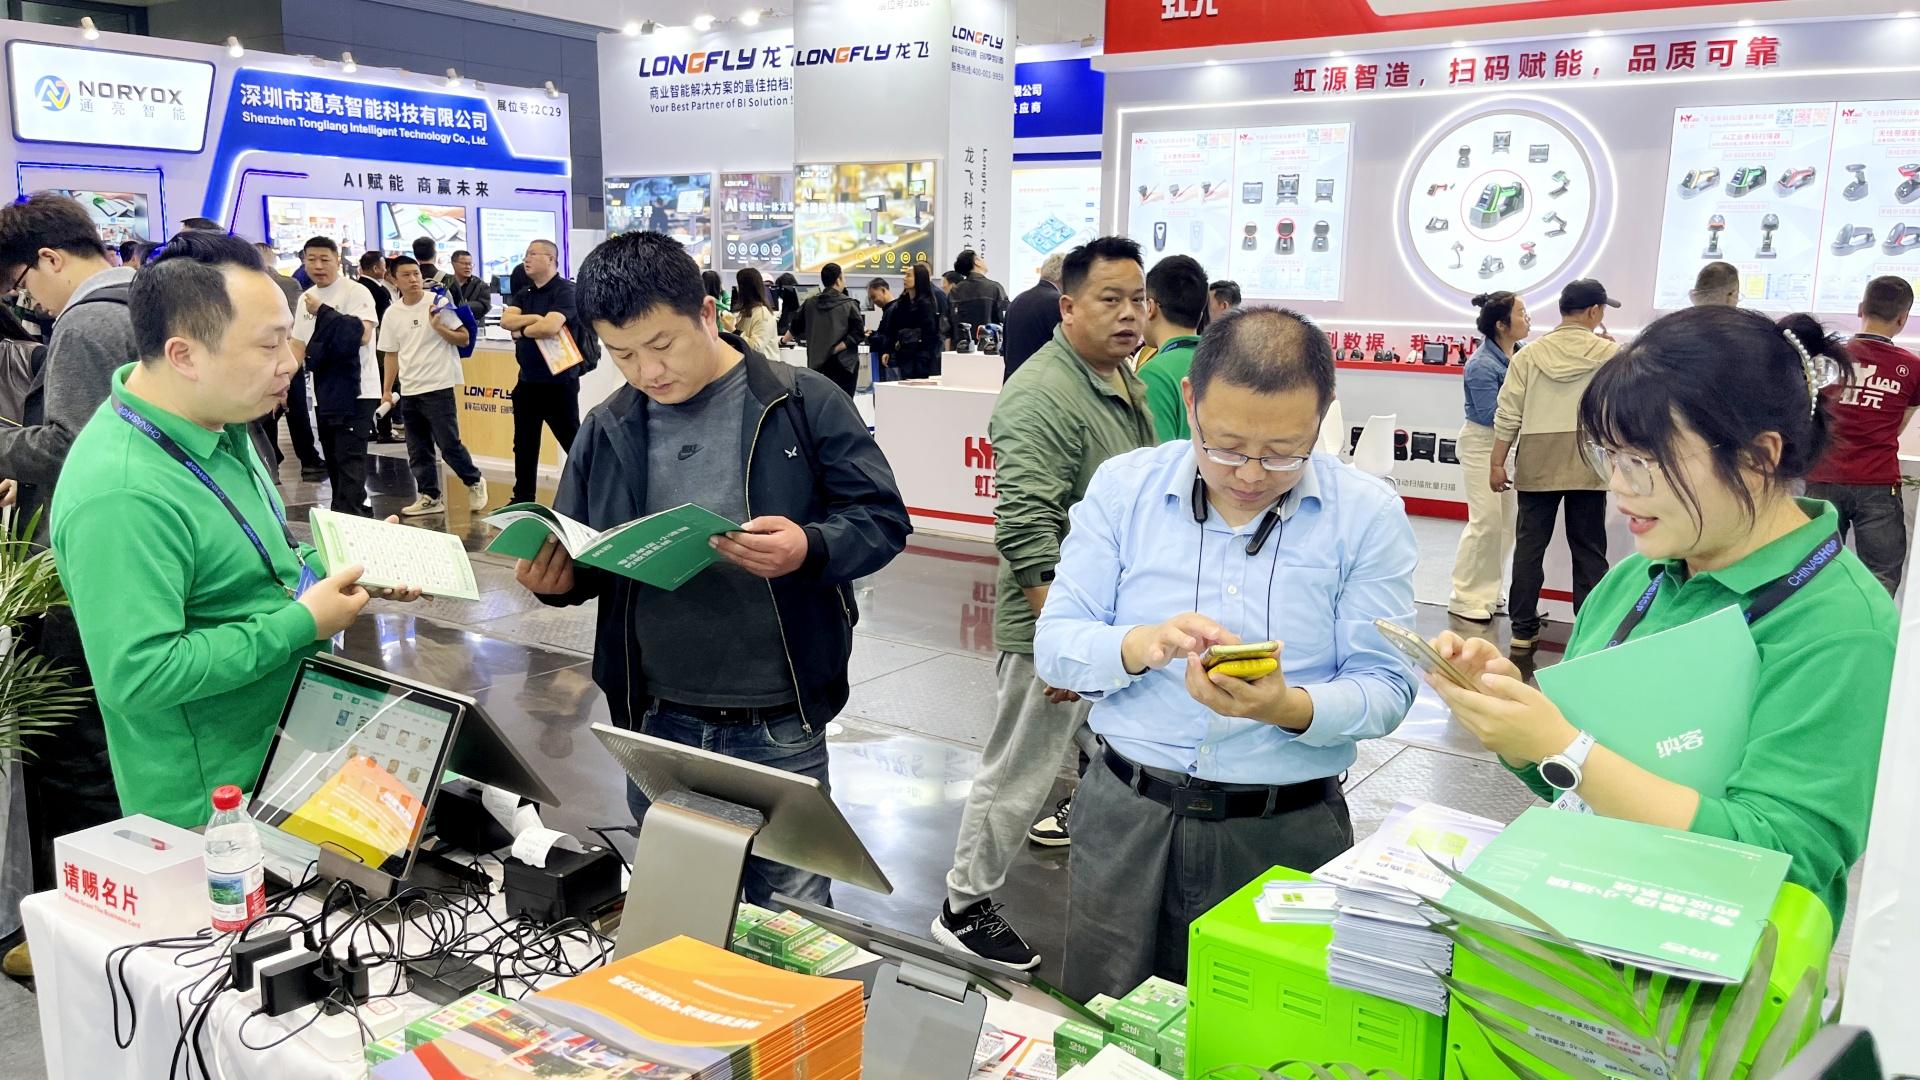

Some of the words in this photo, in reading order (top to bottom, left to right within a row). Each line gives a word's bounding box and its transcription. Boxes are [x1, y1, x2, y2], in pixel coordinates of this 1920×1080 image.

[951, 25, 1004, 49] LONGFLY
[639, 47, 757, 78] LONGFLY
[796, 43, 892, 66] LONGFLY
[896, 41, 929, 60] 龙飞
[79, 80, 184, 106] NORYOX
[650, 77, 793, 100] 商业智能解决方案的最佳拍档!
[80, 98, 186, 121] 通亮智能
[240, 83, 488, 132] 深圳市通亮智能科技有限公司
[497, 99, 562, 118] 展位号:2C29
[650, 103, 669, 113] Your
[671, 101, 689, 112] Best
[691, 99, 723, 111] Partner
[727, 98, 736, 108] of
[737, 98, 747, 108] BI
[749, 96, 788, 107] Solution
[242, 111, 296, 127] Shenzhen
[298, 117, 348, 134] Tongliang
[350, 122, 398, 138] Intelligent
[400, 128, 452, 145] Technology
[453, 133, 471, 145] Co.,
[471, 135, 489, 146] Ltd.
[344, 172, 405, 192] AI赋能
[417, 177, 489, 197] 商赢未来
[725, 198, 738, 213] AI
[118, 406, 161, 440] CHINASHOP
[185, 460, 226, 500] CHINASHOP
[1787, 538, 1838, 587] CHINASHOP
[62, 861, 139, 916] 请赐名片
